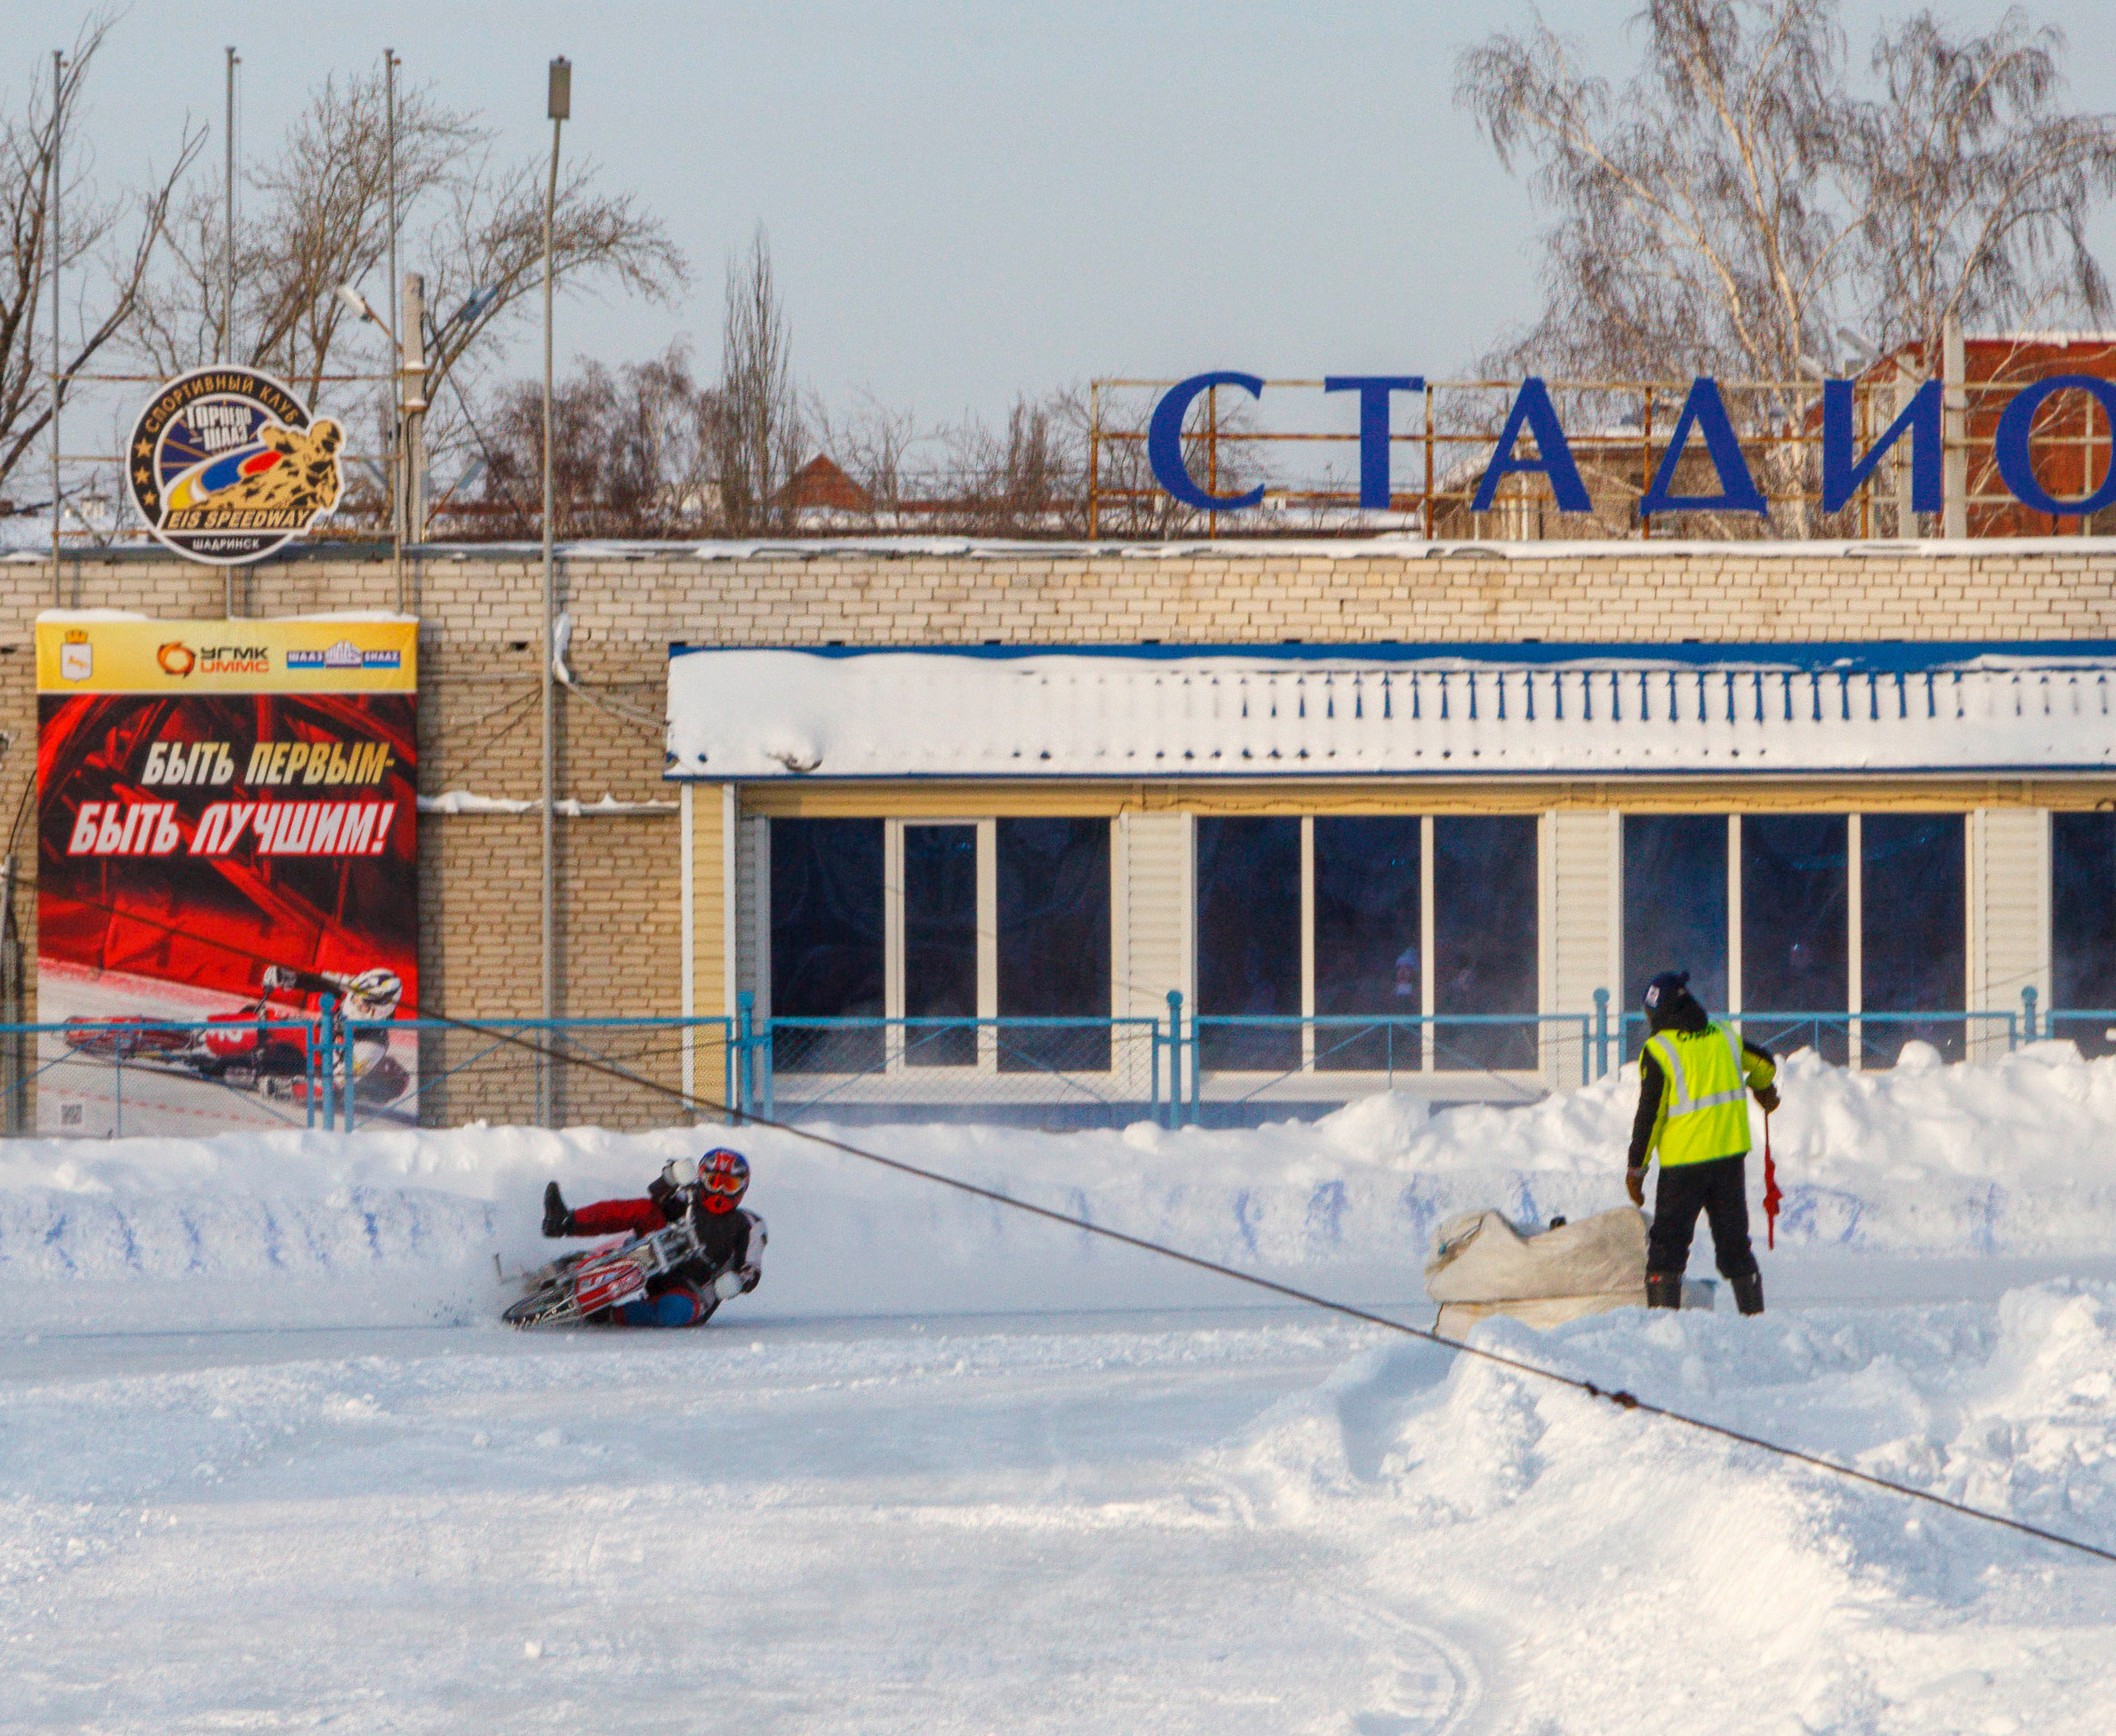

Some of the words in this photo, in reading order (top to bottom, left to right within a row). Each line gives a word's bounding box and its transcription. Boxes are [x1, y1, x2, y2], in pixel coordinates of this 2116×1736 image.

[145, 374, 255, 433] СПОРТИВНЫЙ
[260, 385, 299, 423] КЛУБ
[1147, 370, 2116, 517] СТАДИО
[168, 511, 202, 528] EIS
[204, 510, 311, 528] SPEEDWAY
[192, 538, 261, 551] ШАДРИНСК
[200, 646, 269, 660] УГМК
[200, 660, 270, 673] UMMC
[141, 741, 236, 785] БЫТЬ
[67, 801, 180, 856] БЫТЬ
[188, 801, 396, 856] ЛУЧШИМ!
